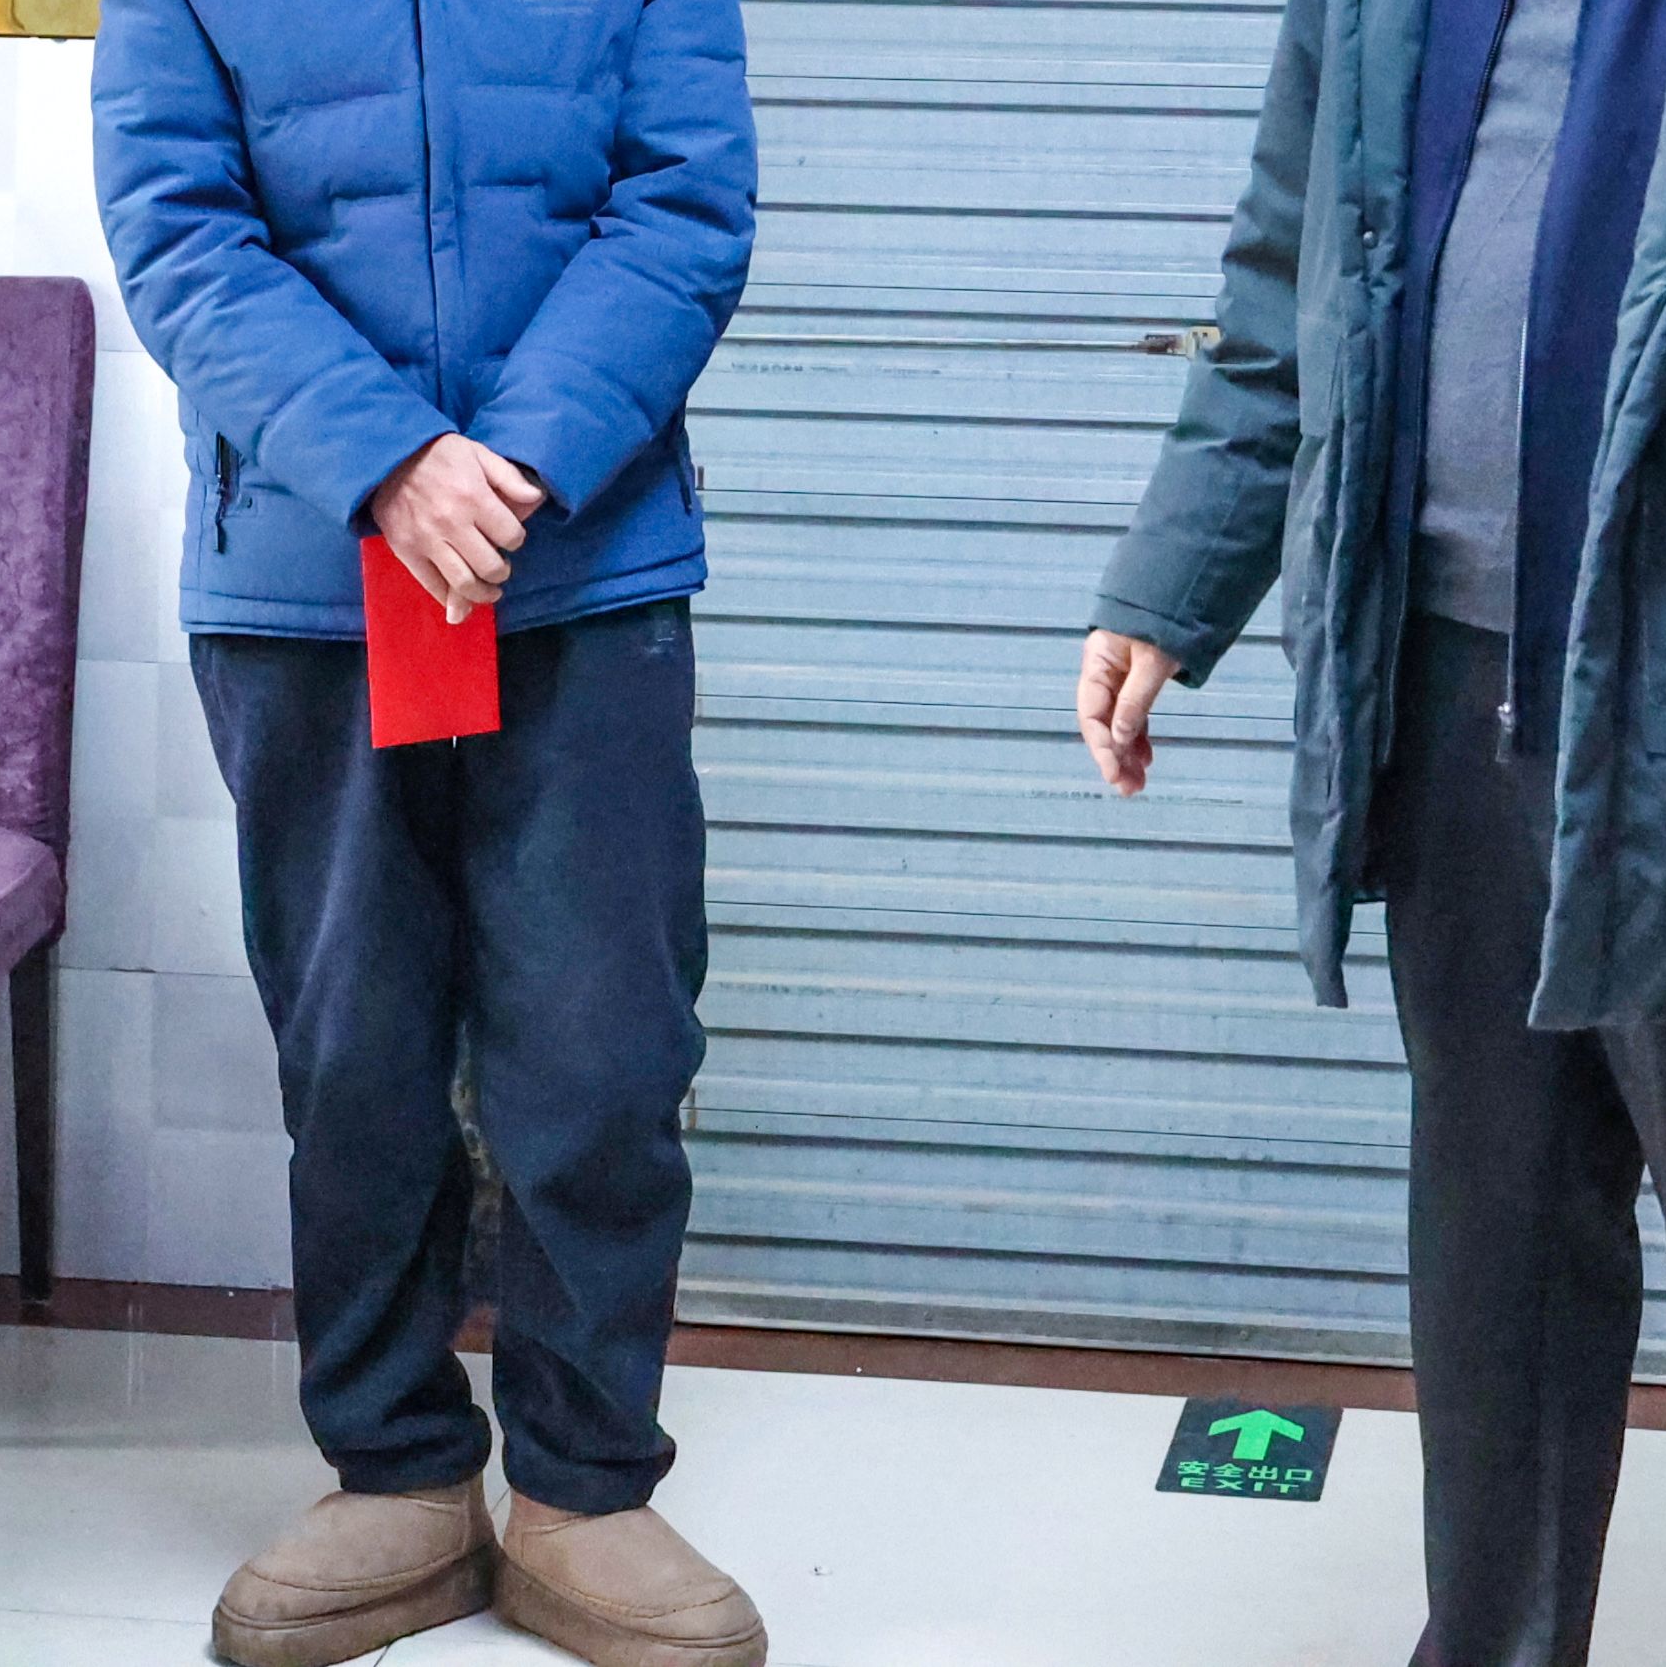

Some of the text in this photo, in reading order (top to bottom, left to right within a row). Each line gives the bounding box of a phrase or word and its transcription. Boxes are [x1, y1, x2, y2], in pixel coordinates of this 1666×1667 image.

[1177, 1460, 1313, 1482] 安全出口
[1180, 1477, 1300, 1494] EXIT
